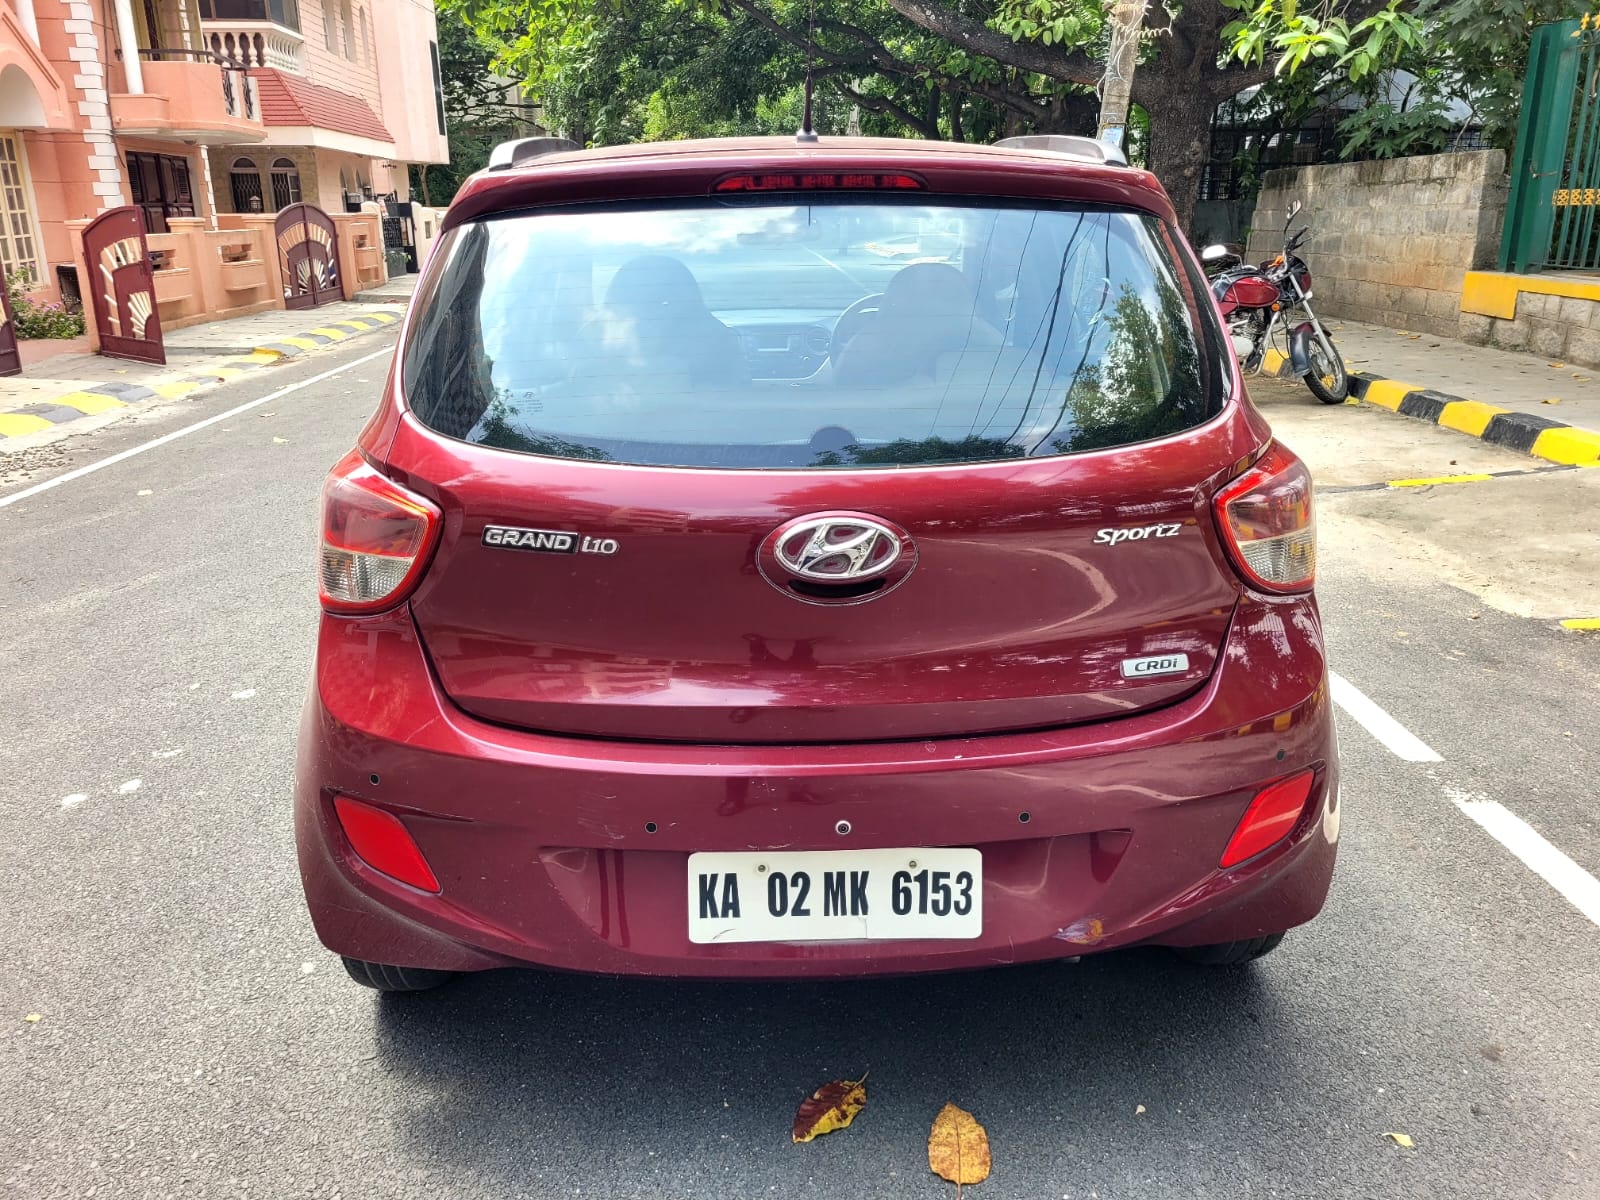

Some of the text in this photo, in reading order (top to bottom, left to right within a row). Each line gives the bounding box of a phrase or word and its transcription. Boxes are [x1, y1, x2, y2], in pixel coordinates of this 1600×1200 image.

[485, 529, 619, 554] GRAND i10
[1093, 523, 1182, 546] Sportz
[1134, 658, 1178, 672] CRDi
[699, 869, 974, 919] KA 02 MK 6153
